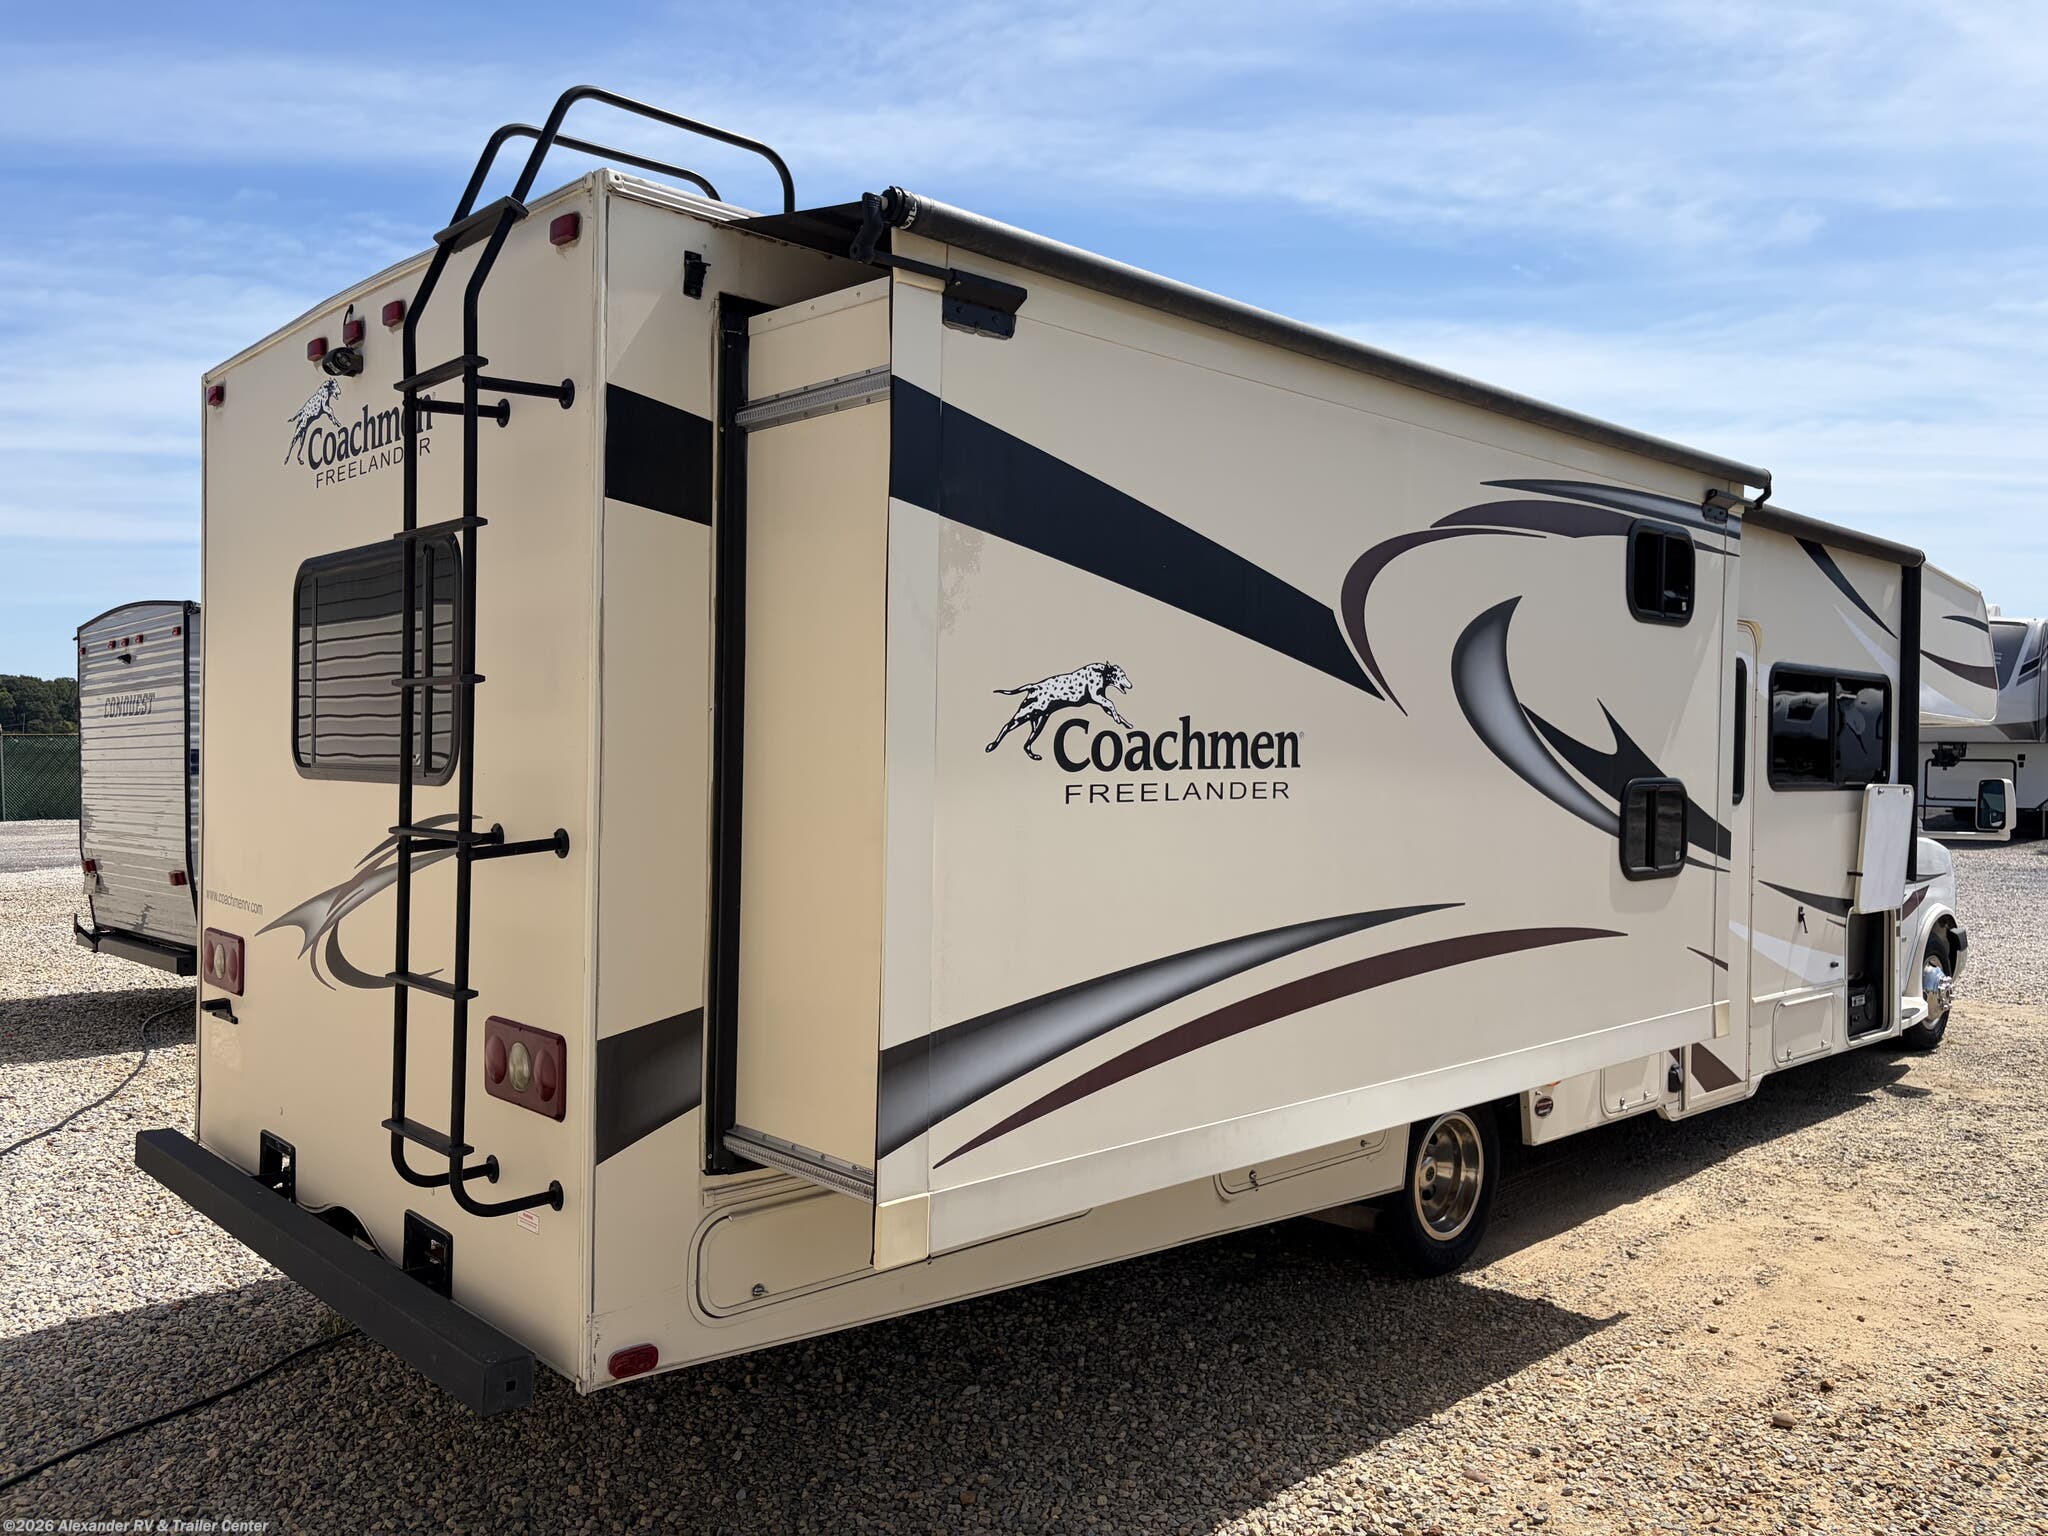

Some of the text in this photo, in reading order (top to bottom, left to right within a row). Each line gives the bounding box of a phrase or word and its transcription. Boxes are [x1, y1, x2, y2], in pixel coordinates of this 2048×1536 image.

[308, 394, 433, 470] Coachmn
[315, 437, 431, 489] FREELANDR
[103, 692, 156, 718] CONQUEST
[1053, 715, 1301, 773] Coachmen
[1065, 781, 1290, 804] FREELANDER
